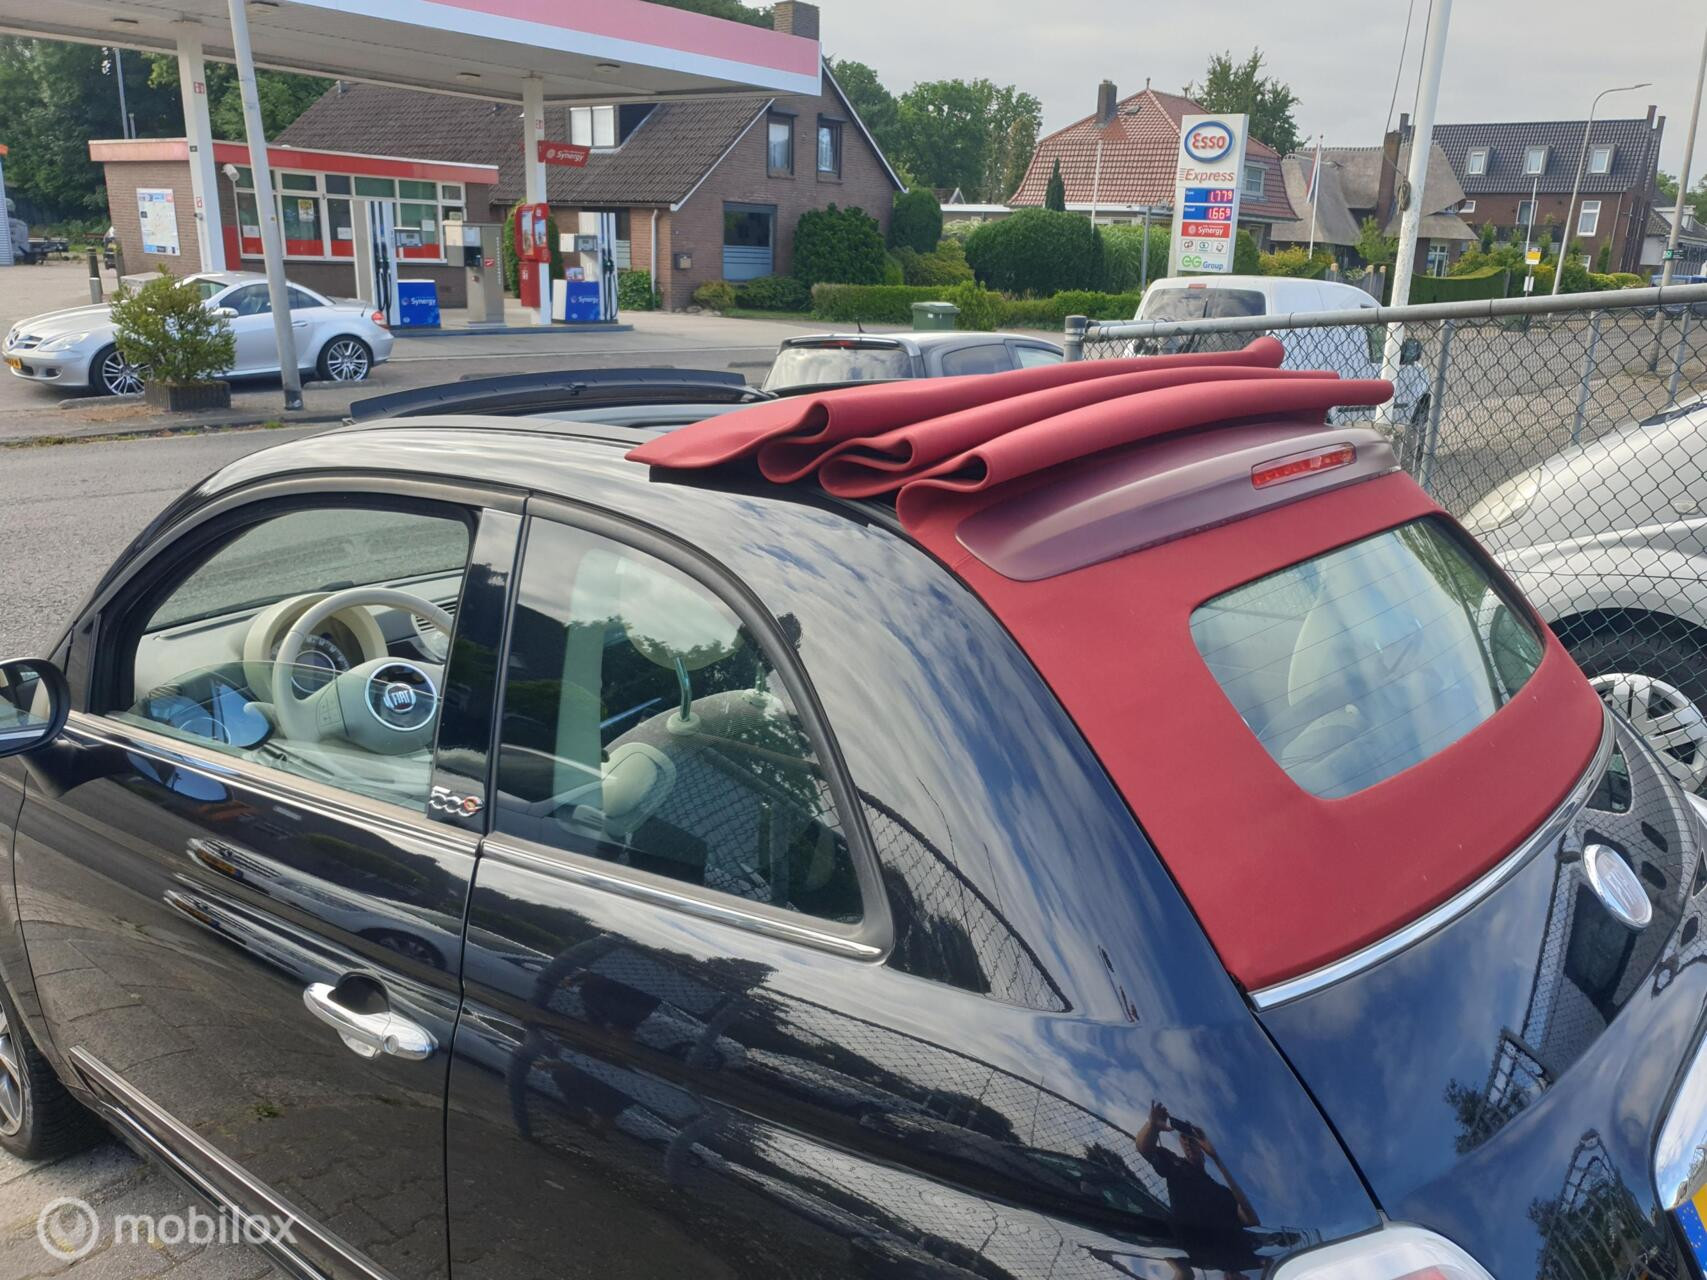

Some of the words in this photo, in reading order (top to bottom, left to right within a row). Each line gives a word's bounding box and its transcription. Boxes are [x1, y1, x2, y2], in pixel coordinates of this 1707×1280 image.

[1191, 132, 1226, 150] Esso
[556, 150, 585, 162] Synergy
[1184, 168, 1234, 184] Express
[1197, 226, 1224, 237] Synergy
[1202, 260, 1224, 271] Group
[390, 690, 410, 706] FIAT
